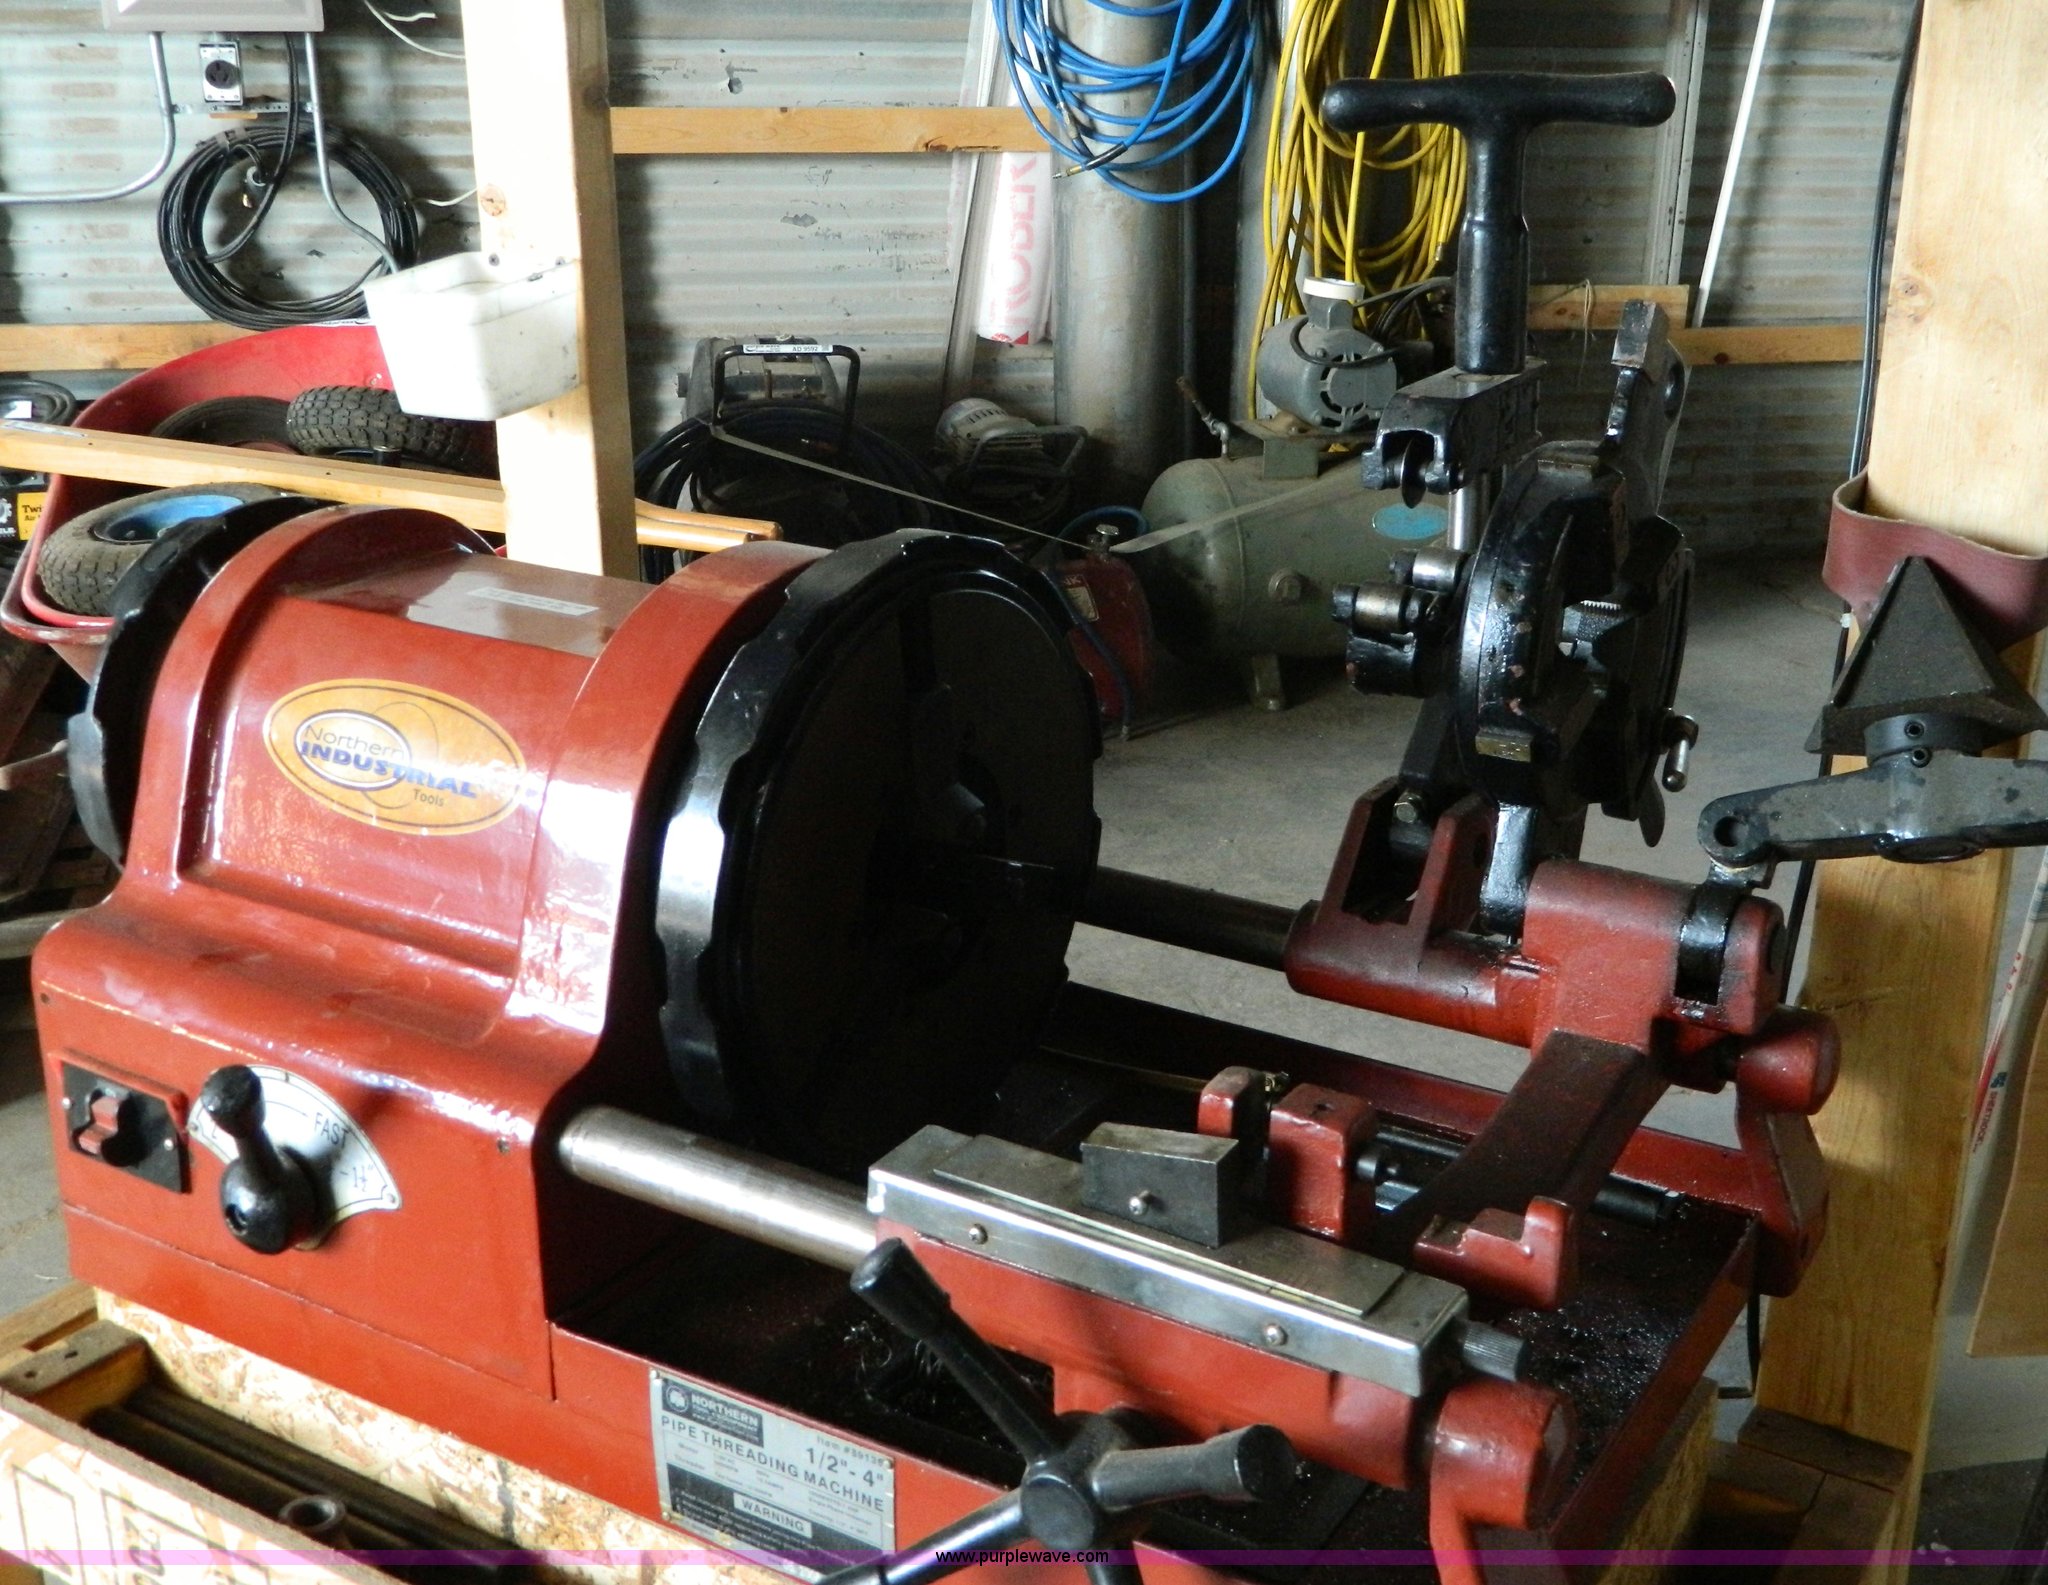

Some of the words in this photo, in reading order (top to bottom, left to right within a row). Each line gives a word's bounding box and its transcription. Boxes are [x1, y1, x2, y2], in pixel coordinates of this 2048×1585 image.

[303, 723, 405, 762] Northern
[301, 740, 478, 799] INDUSTRIAL
[412, 788, 446, 807] Tools
[314, 1111, 351, 1149] FAST
[691, 1393, 759, 1427] NORTHERN
[661, 1414, 697, 1439] PIPE
[701, 1429, 798, 1478] THREADING
[804, 1469, 885, 1512] MACHINE
[805, 1447, 848, 1474] 1/2"
[863, 1469, 884, 1488] 4"
[741, 1500, 805, 1533] WARNING
